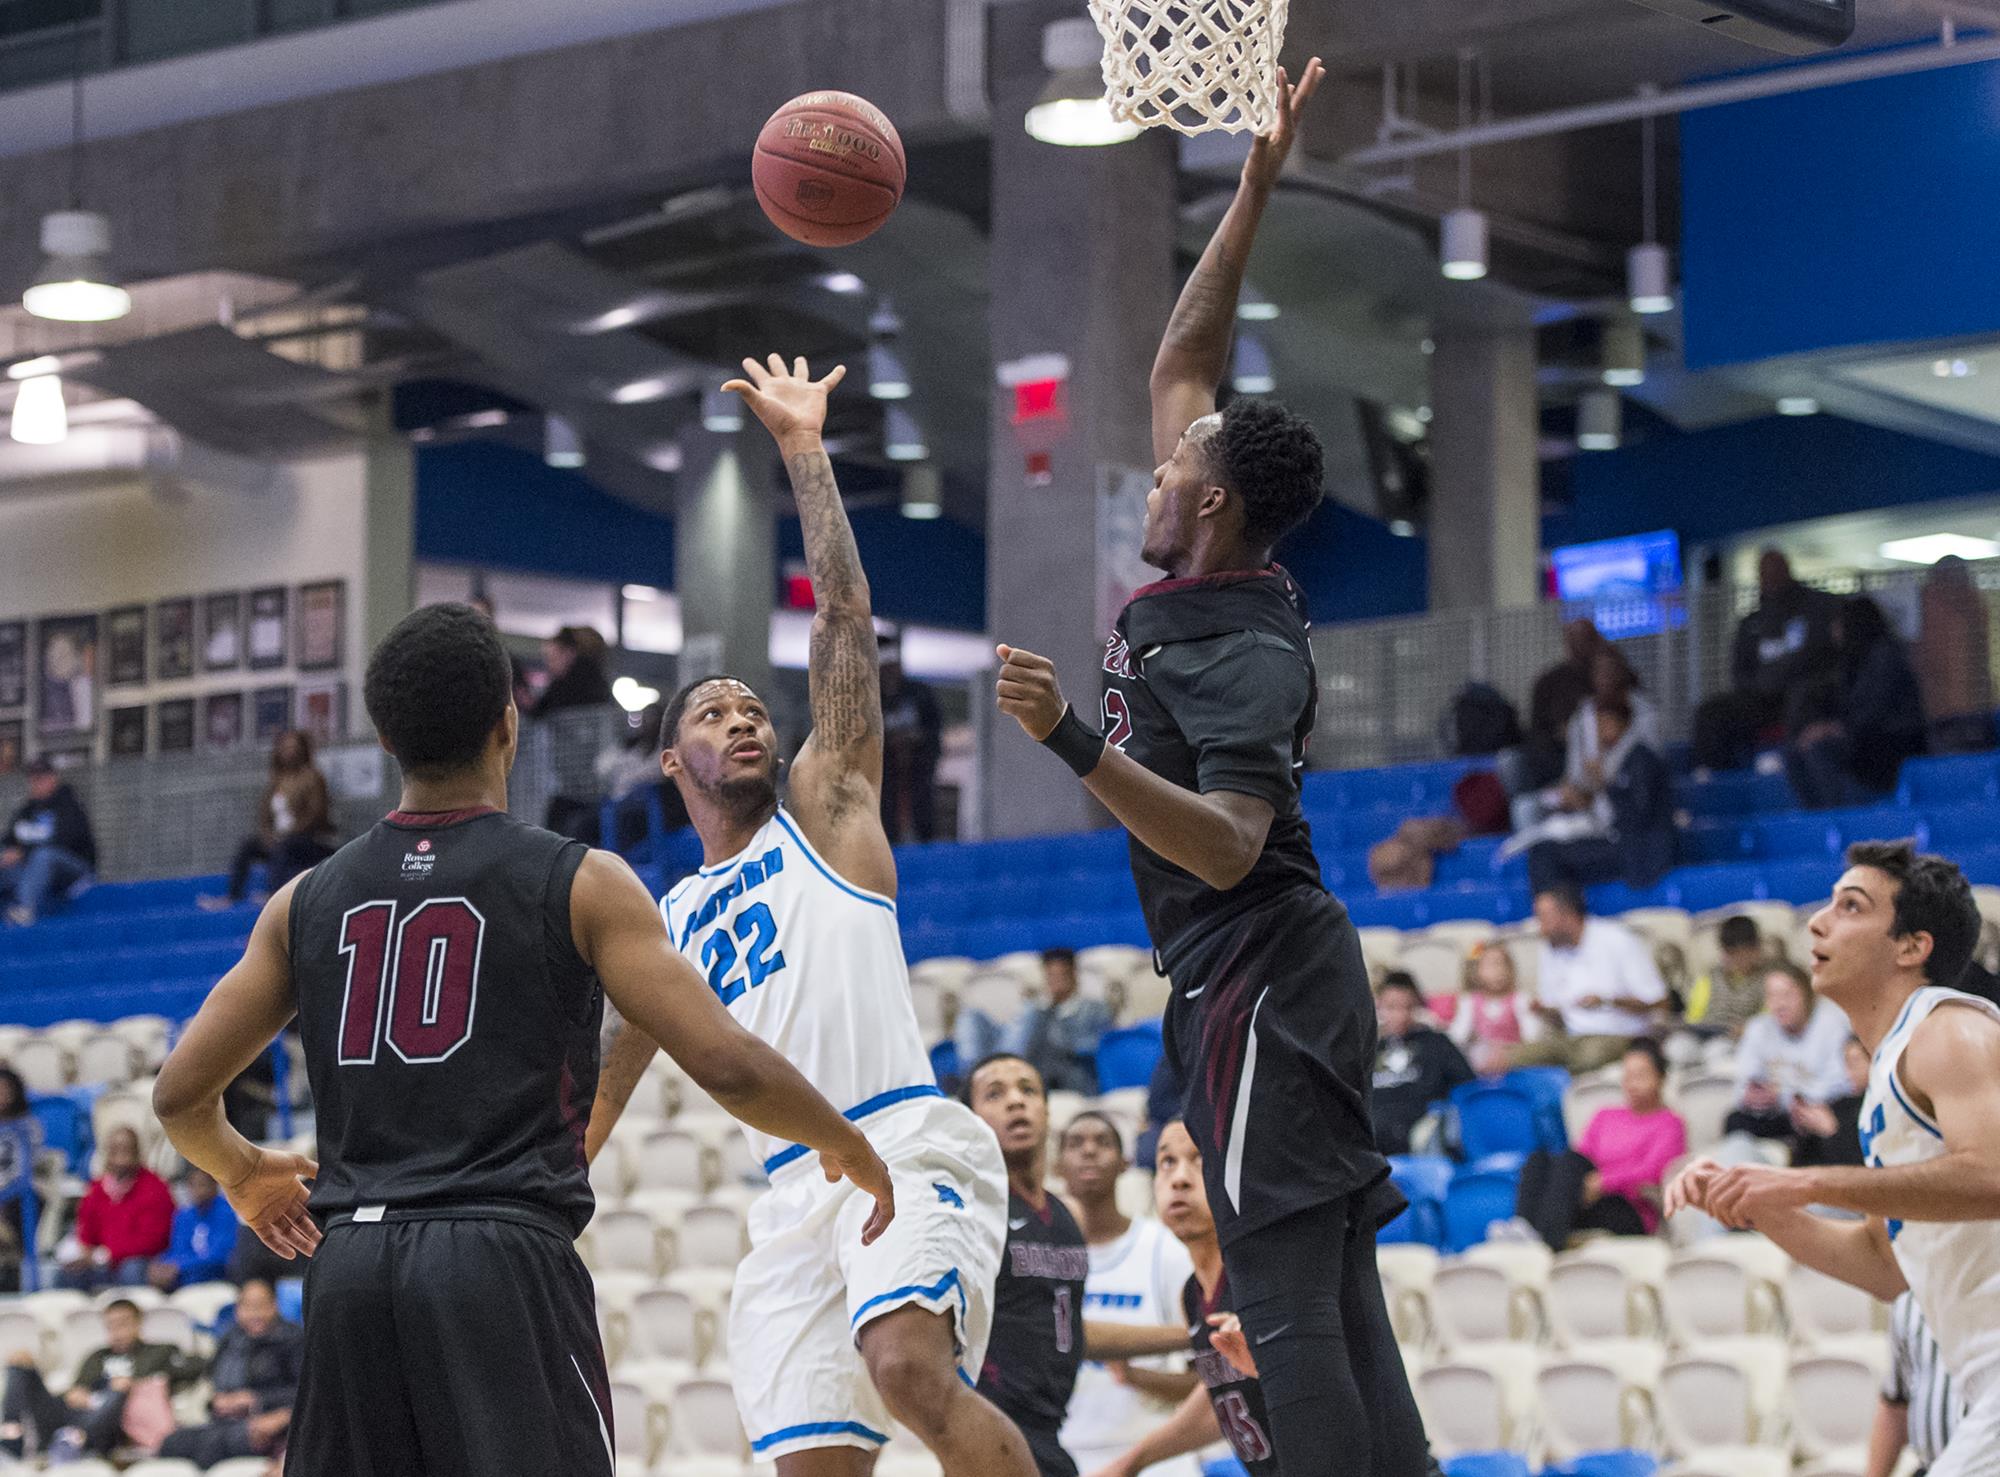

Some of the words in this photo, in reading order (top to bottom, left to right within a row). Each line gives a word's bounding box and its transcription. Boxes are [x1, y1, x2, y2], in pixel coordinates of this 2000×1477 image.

[401, 862, 434, 872] College
[403, 853, 436, 862] Rowan
[338, 896, 486, 1066] 10
[701, 901, 786, 1007] 22
[1053, 1285, 1073, 1353] 1
